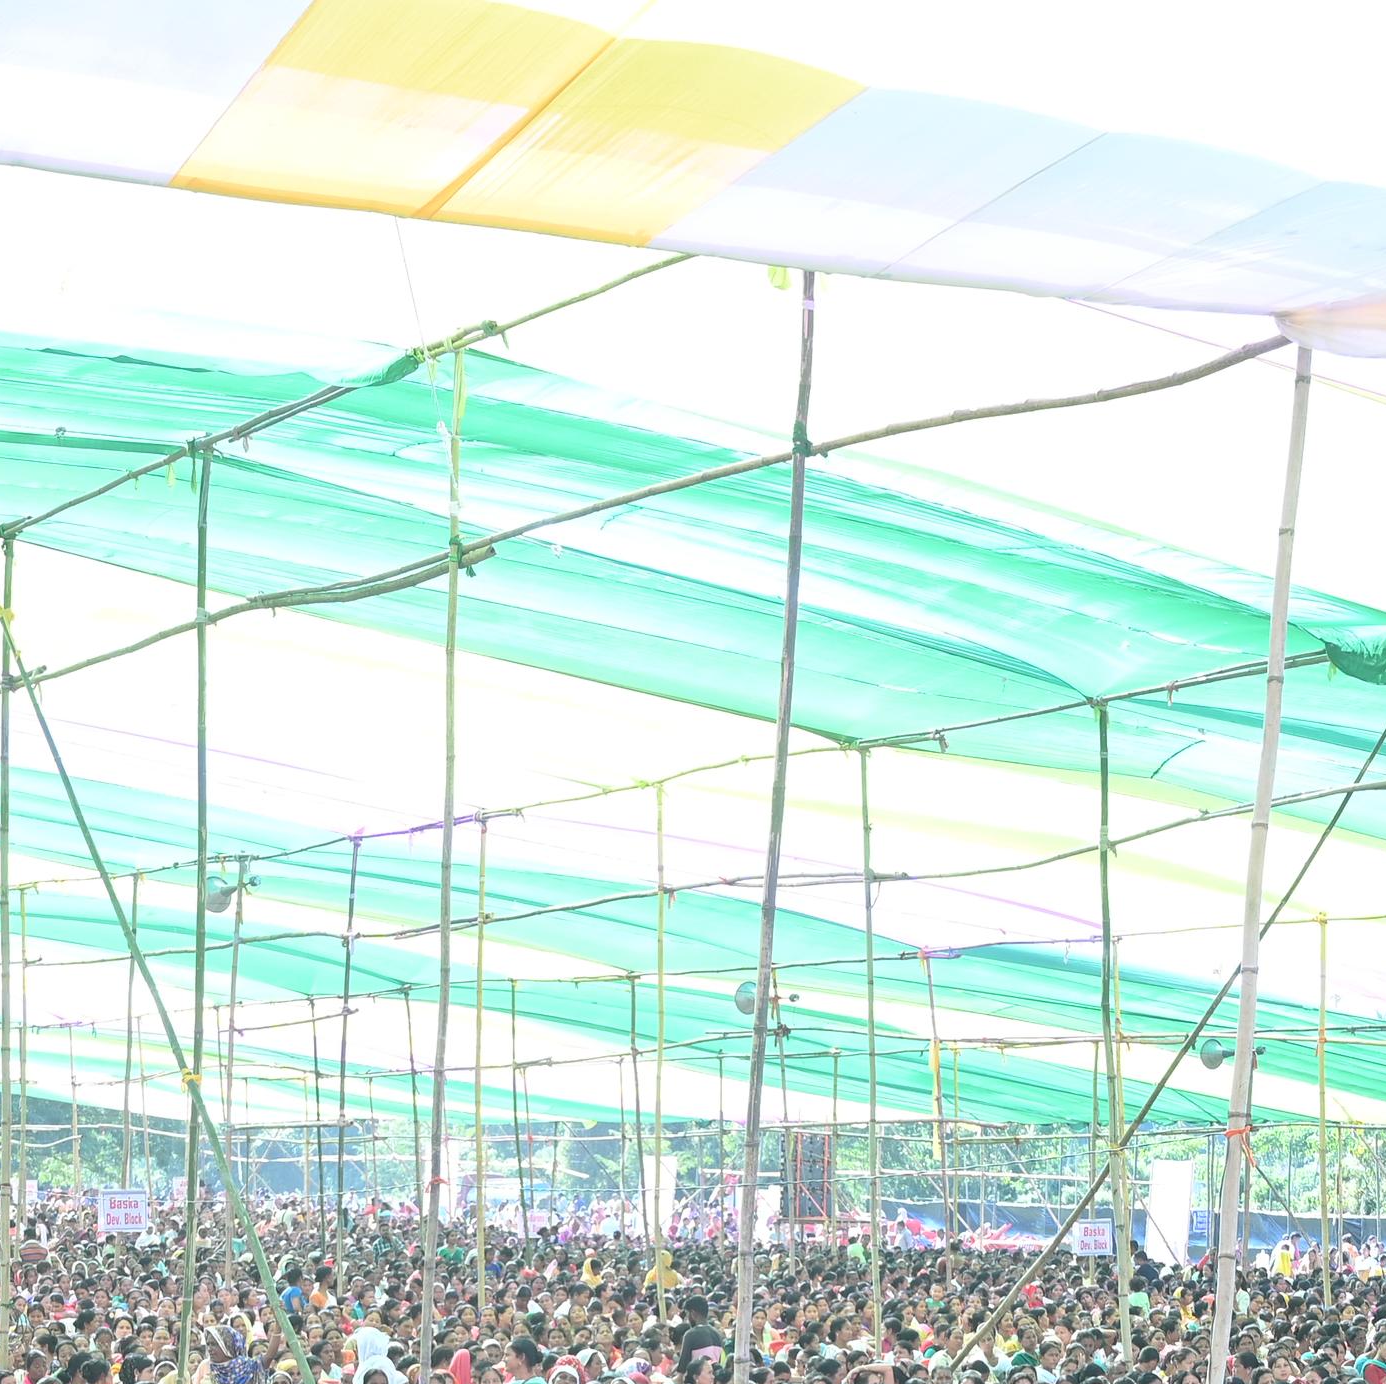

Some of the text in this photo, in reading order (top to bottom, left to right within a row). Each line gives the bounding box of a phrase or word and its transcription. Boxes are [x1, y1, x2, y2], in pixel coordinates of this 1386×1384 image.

[109, 1196, 139, 1210] Baska
[106, 1211, 143, 1226] Dev. Block
[1083, 1226, 1106, 1237] Baska
[1080, 1239, 1108, 1250] Dev. Block
